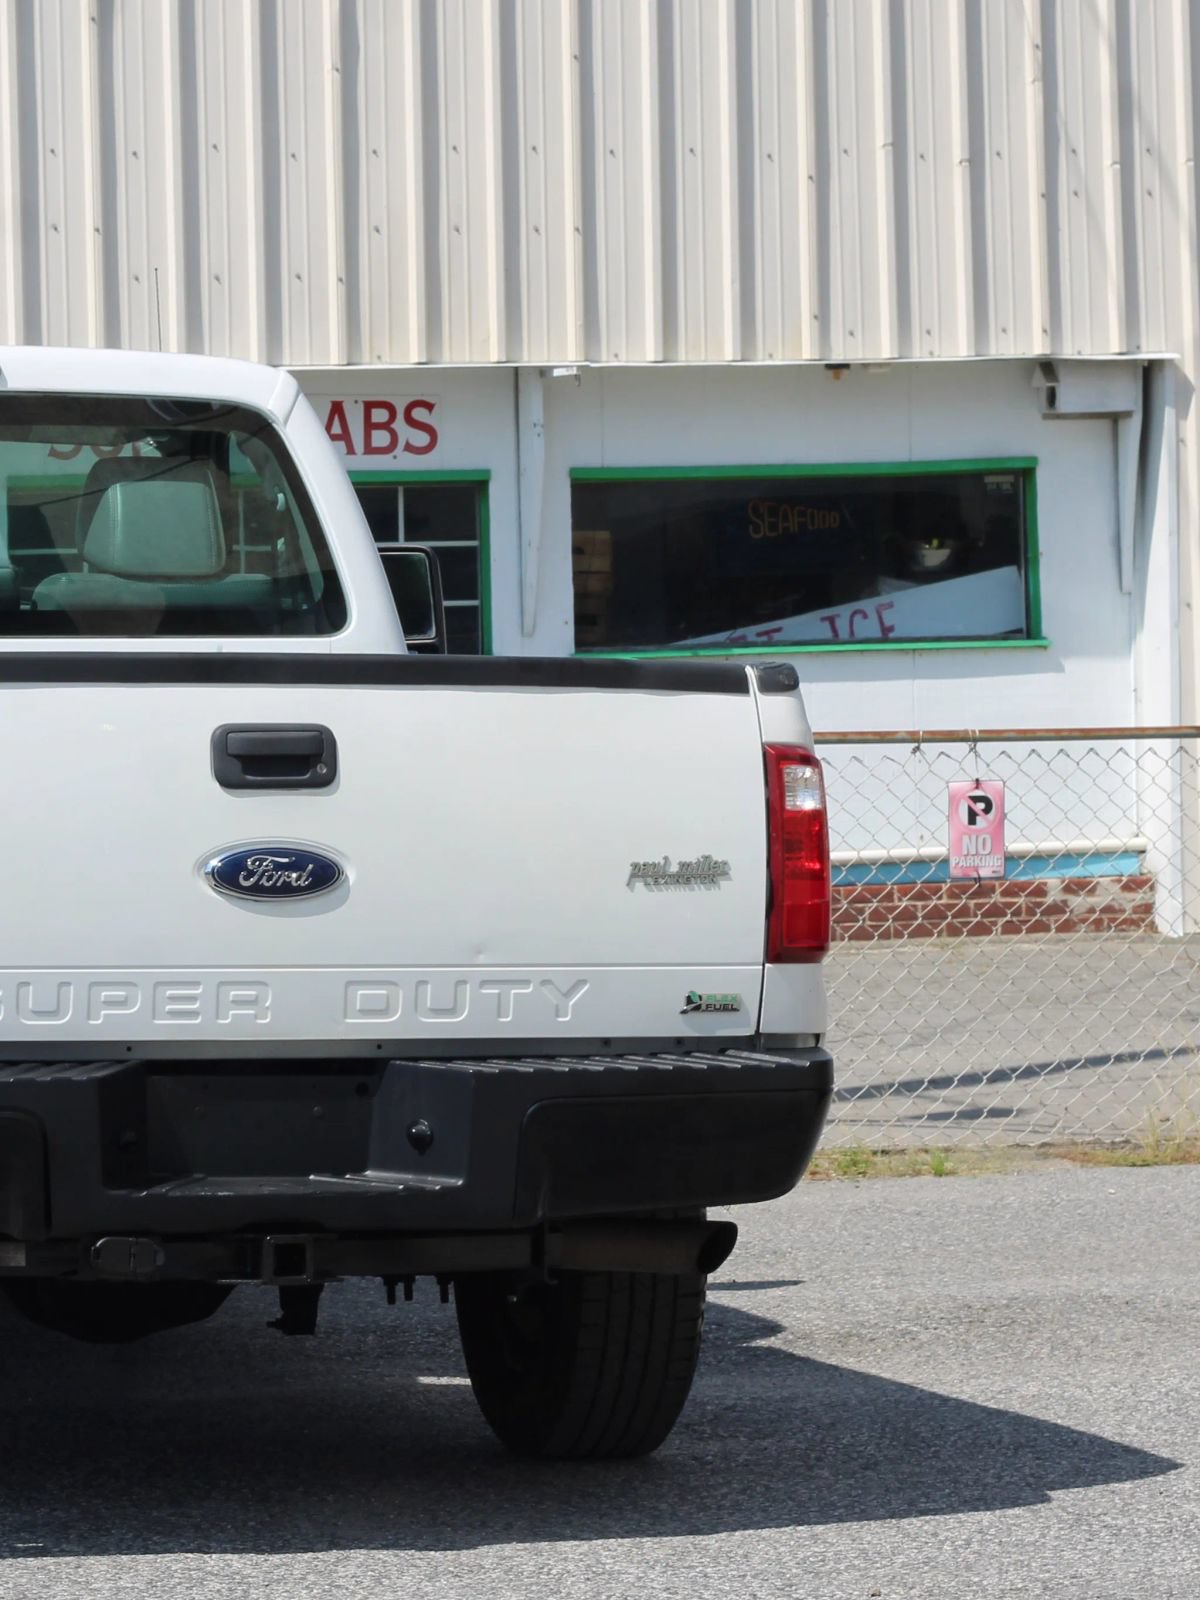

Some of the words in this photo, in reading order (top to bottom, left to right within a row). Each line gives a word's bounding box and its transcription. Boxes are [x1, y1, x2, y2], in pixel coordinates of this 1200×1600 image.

[748, 499, 841, 539] SEAFOOD
[962, 833, 993, 856] NO
[238, 855, 315, 887] Ford
[952, 855, 1003, 869] PARKING
[344, 979, 591, 1023] DUTY
[703, 1003, 738, 1012] FUEL
